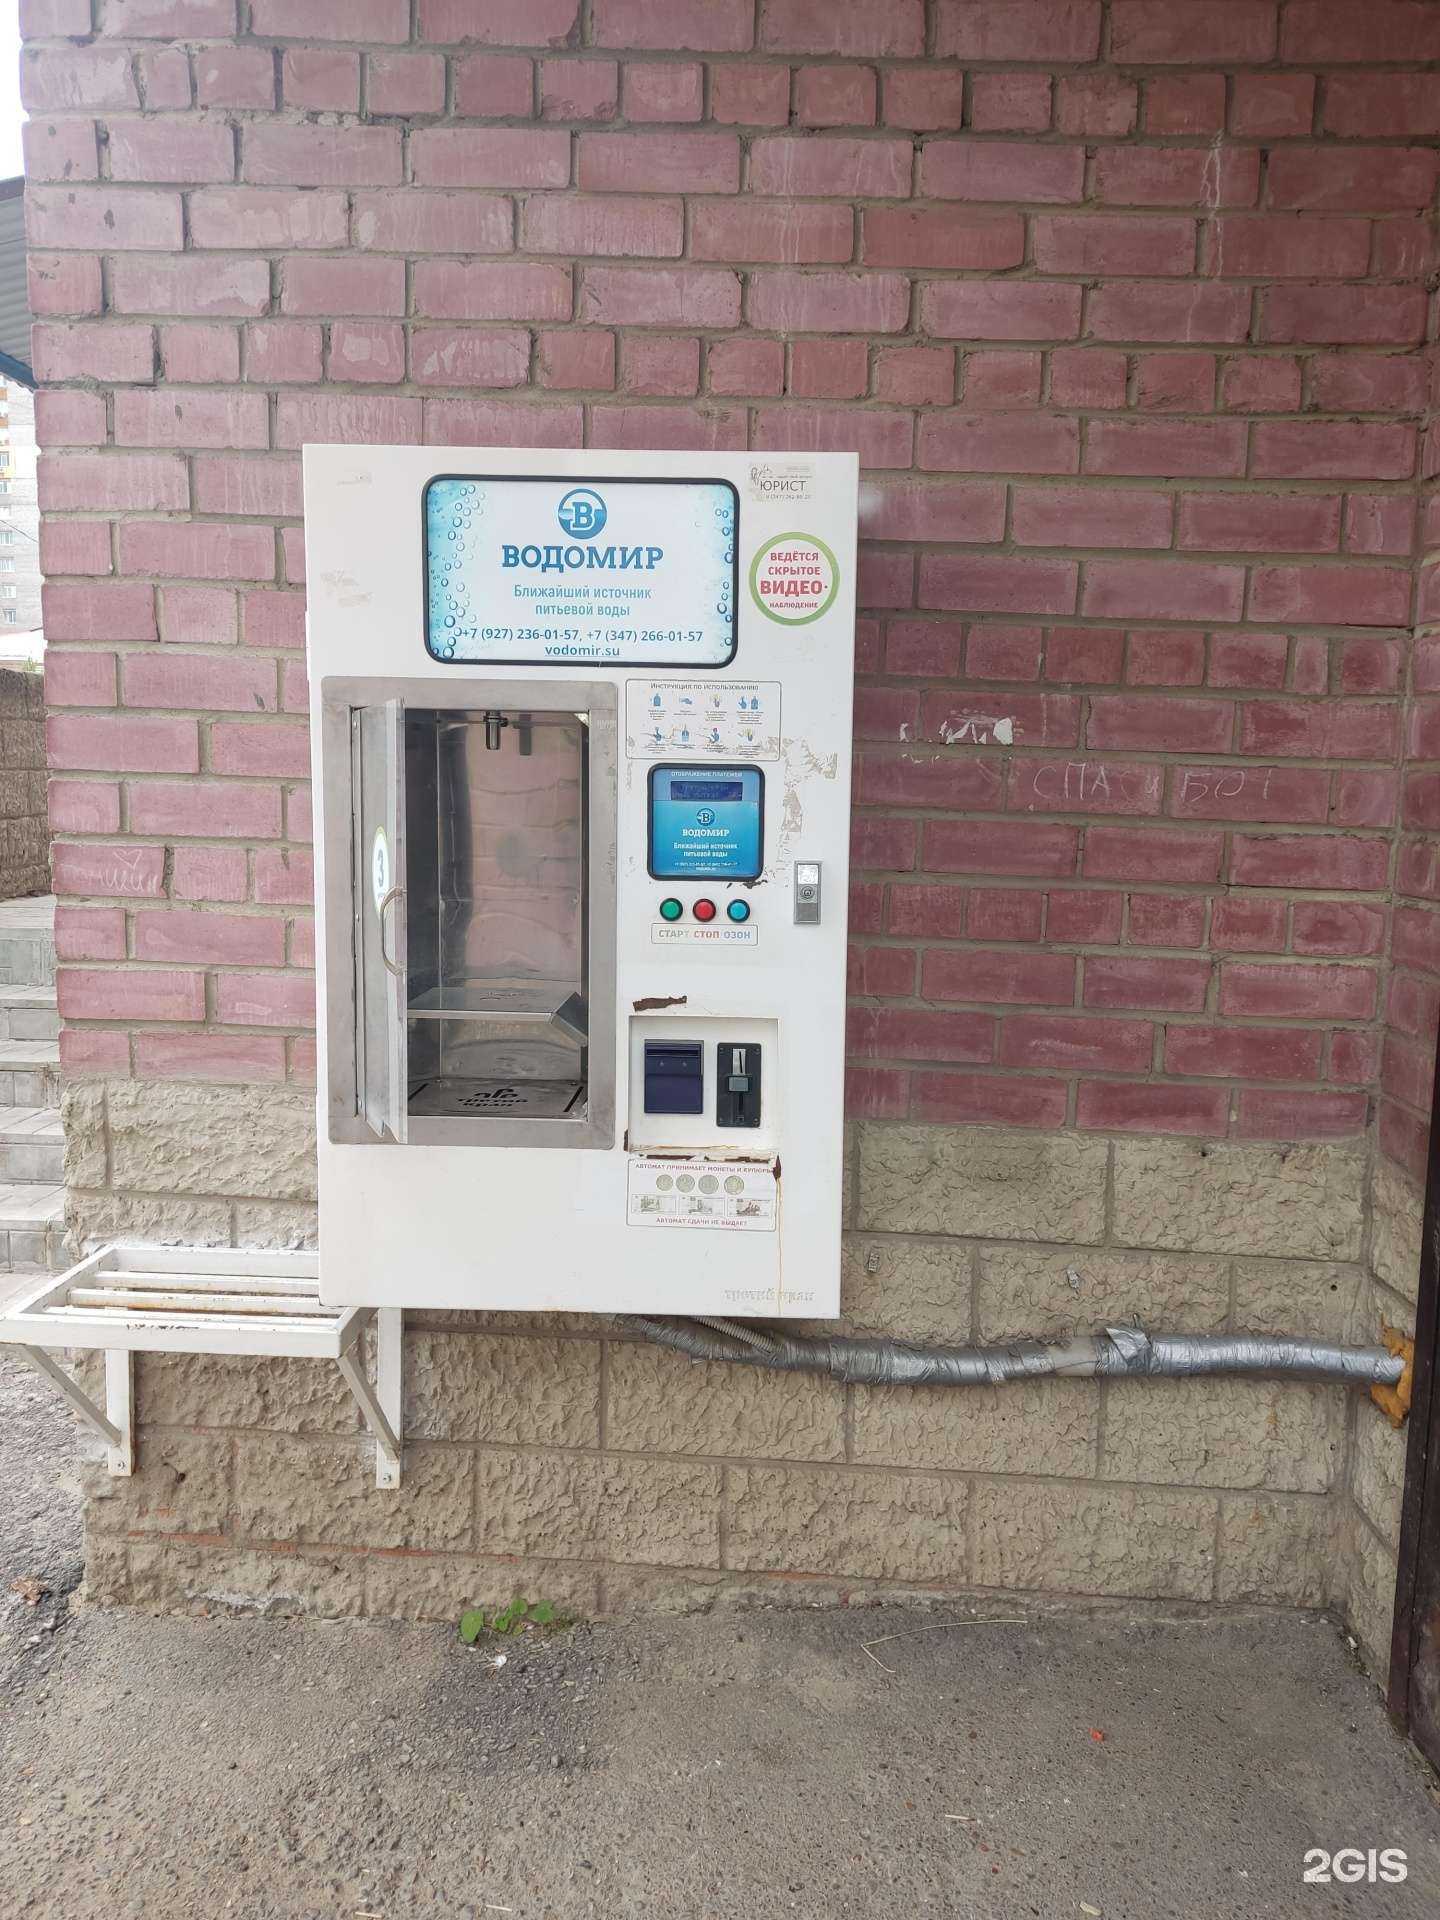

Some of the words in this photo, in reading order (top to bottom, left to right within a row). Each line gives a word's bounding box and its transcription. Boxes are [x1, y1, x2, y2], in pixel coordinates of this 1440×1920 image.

[759, 480, 807, 492] ЮРИСТ
[501, 544, 664, 573] ВОДОМИР
[770, 550, 819, 562] ВЕДЁТСЯ
[768, 566, 821, 575] СКРЫТОЕ
[514, 583, 591, 599] Ближайший
[593, 585, 651, 600] источник
[535, 602, 593, 616] питьевой
[597, 605, 630, 617] воды
[462, 629, 477, 640] +7
[481, 628, 513, 641] (927)
[516, 629, 583, 642] 236-01-57,
[587, 630, 602, 641] +7
[605, 629, 638, 643] (347)
[641, 630, 703, 642] 266-01-57
[544, 643, 621, 656] vodomir.su
[682, 828, 730, 838] ВОДОМИР
[694, 930, 720, 939] СТОП
[723, 930, 751, 939] ОЗОН
